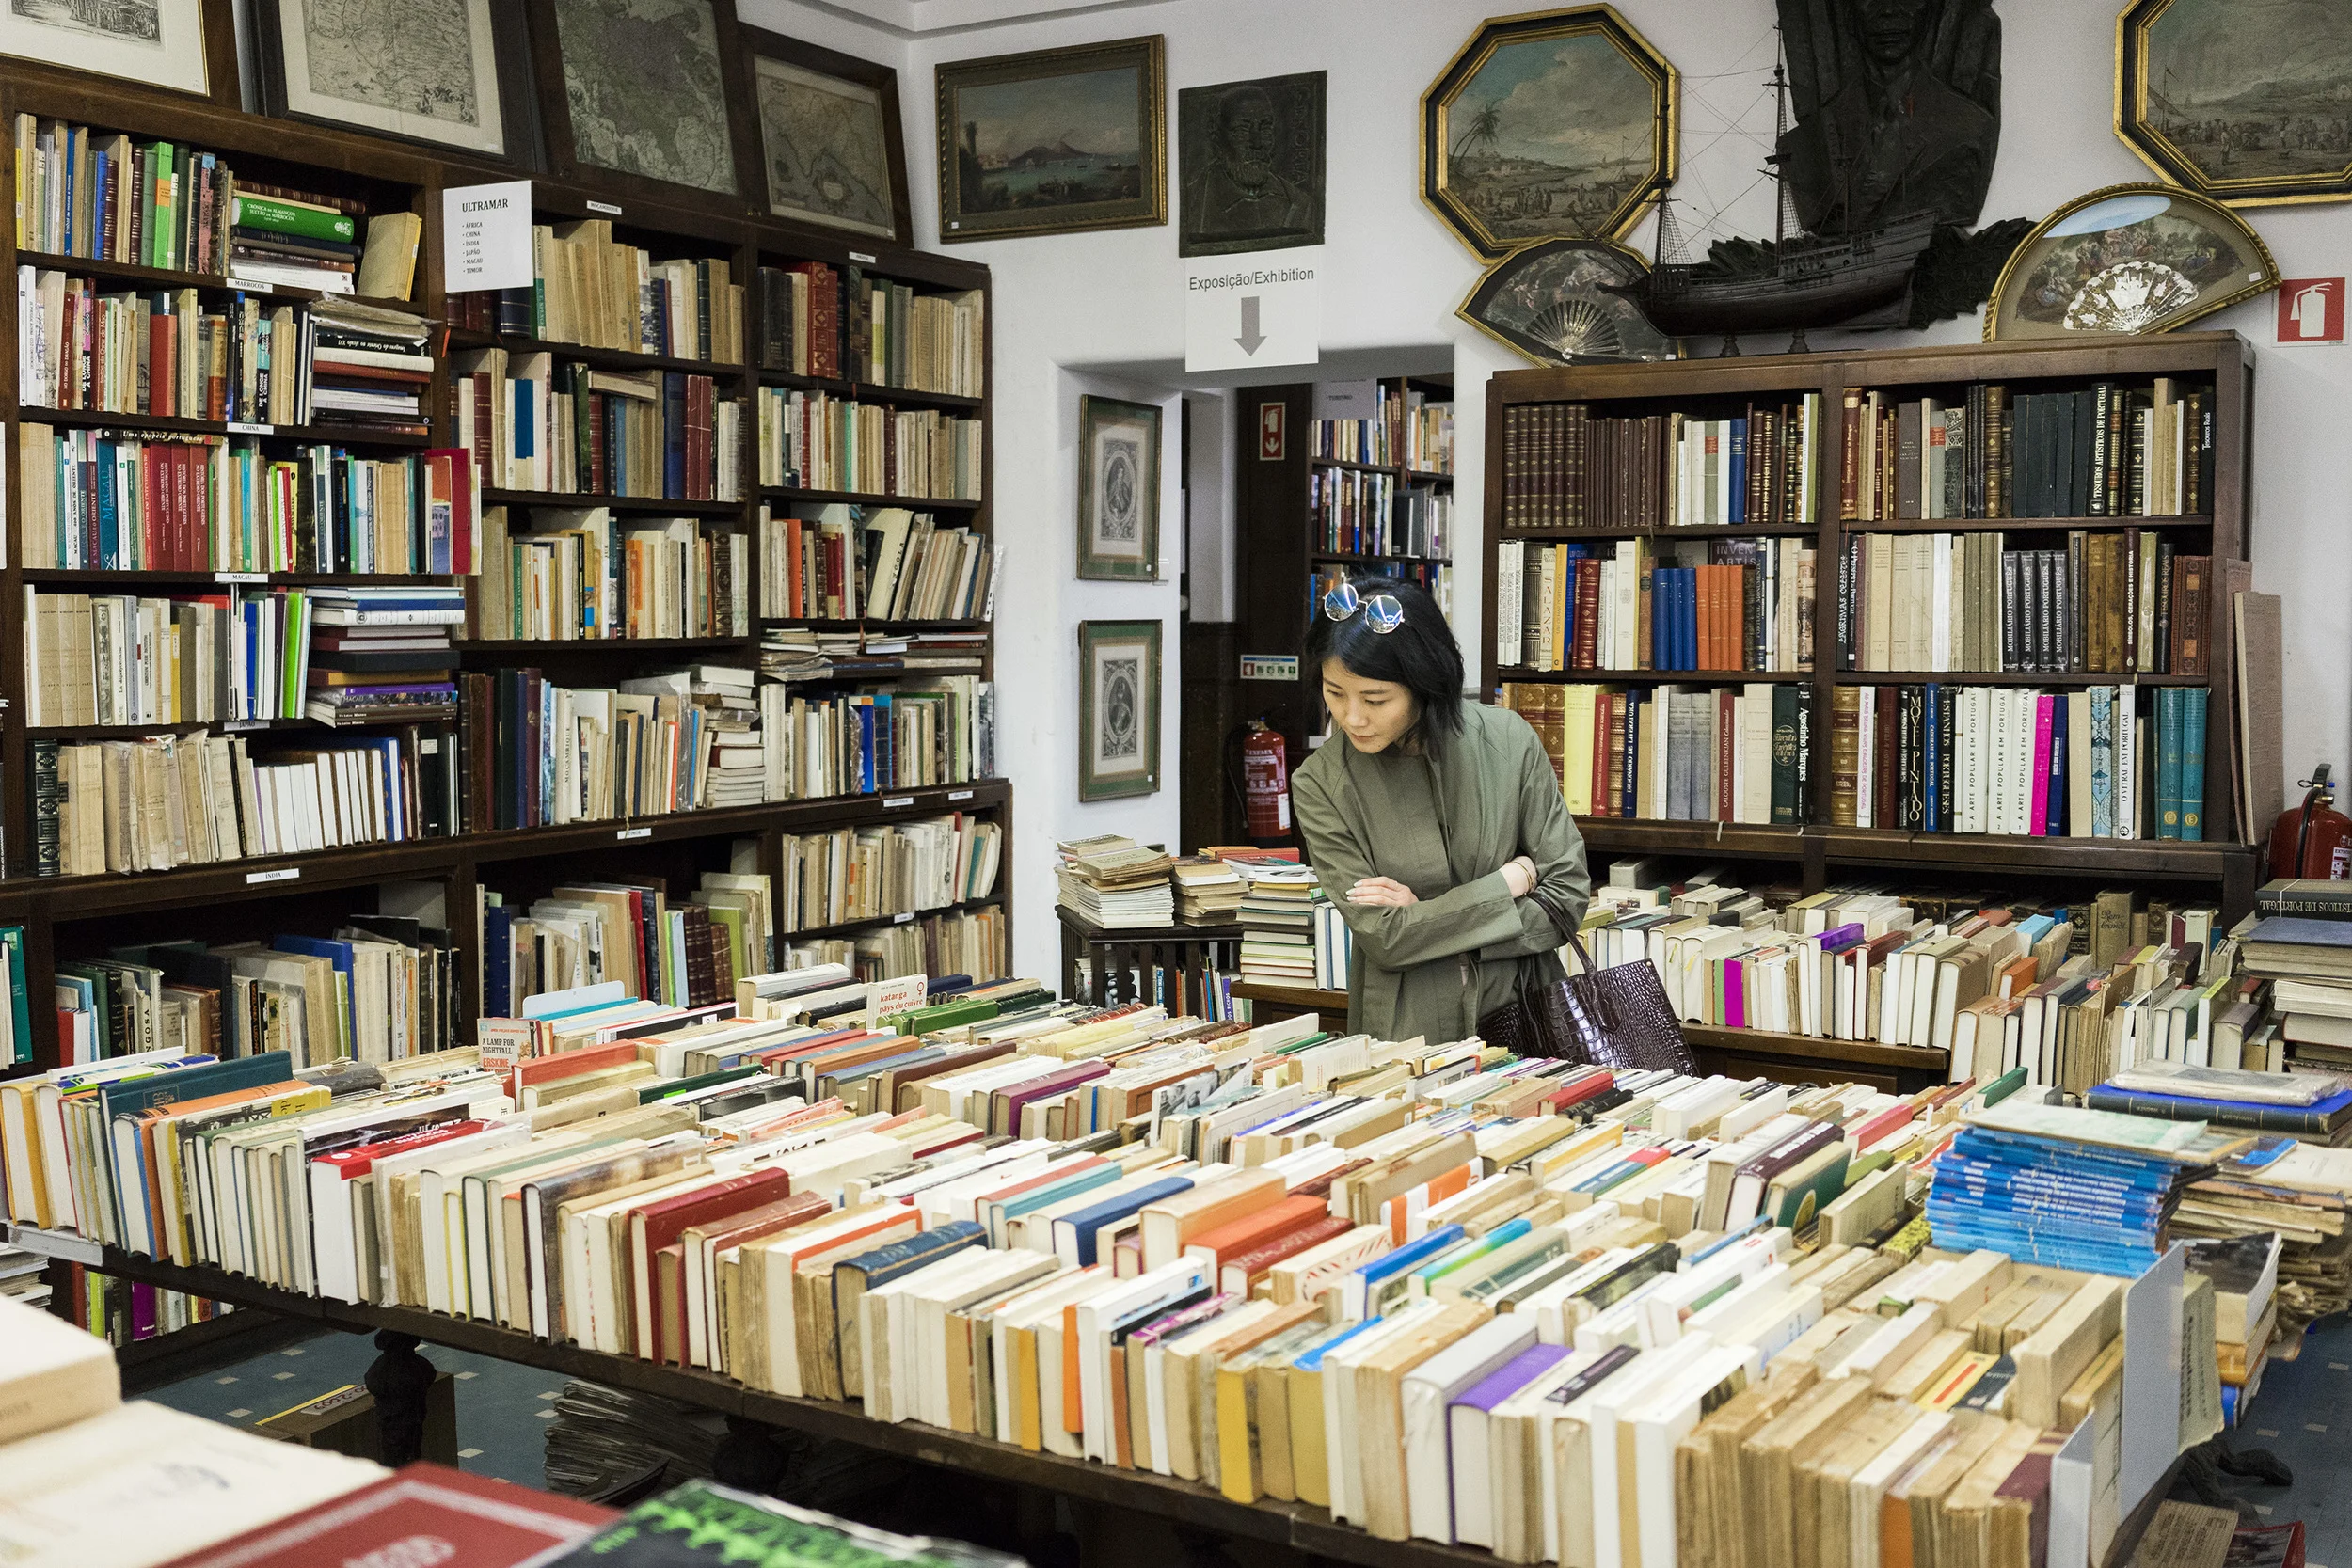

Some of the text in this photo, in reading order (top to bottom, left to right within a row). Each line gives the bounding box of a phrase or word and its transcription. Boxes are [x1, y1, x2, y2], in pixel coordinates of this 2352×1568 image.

[247, 203, 267, 212] CRÓNICA
[462, 198, 509, 213] ULTRAMAR
[466, 248, 481, 257] JAPÃO
[235, 280, 265, 289] MARROCOS
[1189, 268, 1314, 292] Exposição/Exhibition
[259, 397, 264, 408] DE
[123, 430, 203, 443] Uma epopeia portuguesa
[2093, 385, 2106, 498] TESOUROS ARTÍSTICOS DE PORTUGAL
[2202, 426, 2211, 450] Tesouros
[72, 490, 76, 499] DE
[102, 470, 113, 520] MACAU
[2160, 554, 2170, 616] TESOUROS REAIS
[2006, 566, 2014, 652] MOBILIÁRIO PORTUGUÊS
[2024, 566, 2032, 652] MOBILIÁRIO PORTUGUÊS
[2042, 566, 2050, 652] MOBILIÁRIO PORTUGUÊS
[2055, 566, 2063, 653] MOBILIÁRIO PORTUGUÊS
[2126, 614, 2135, 645] SÍMBOLOS,
[1864, 692, 1869, 701] AS
[1798, 707, 1809, 747] Agostinho
[1970, 737, 1976, 748] EM
[1998, 737, 2005, 748] EM
[2020, 737, 2026, 748] EM
[1628, 745, 1633, 755] DE
[1942, 699, 1951, 815] ESTANHOS PORTUGUESES
[1798, 748, 1809, 782] Marques
[2122, 752, 2129, 766] EM
[1909, 751, 1923, 822] PINTADO
[2259, 900, 2352, 913] ÍSTICOS DE PORTUGAL
[881, 990, 908, 1003] katanga
[879, 1004, 895, 1015] pays
[904, 999, 923, 1008] cuivre
[503, 1038, 516, 1047] FOR
[482, 1046, 513, 1054] NIGHTFALL
[483, 1057, 509, 1068] ERSKINE
